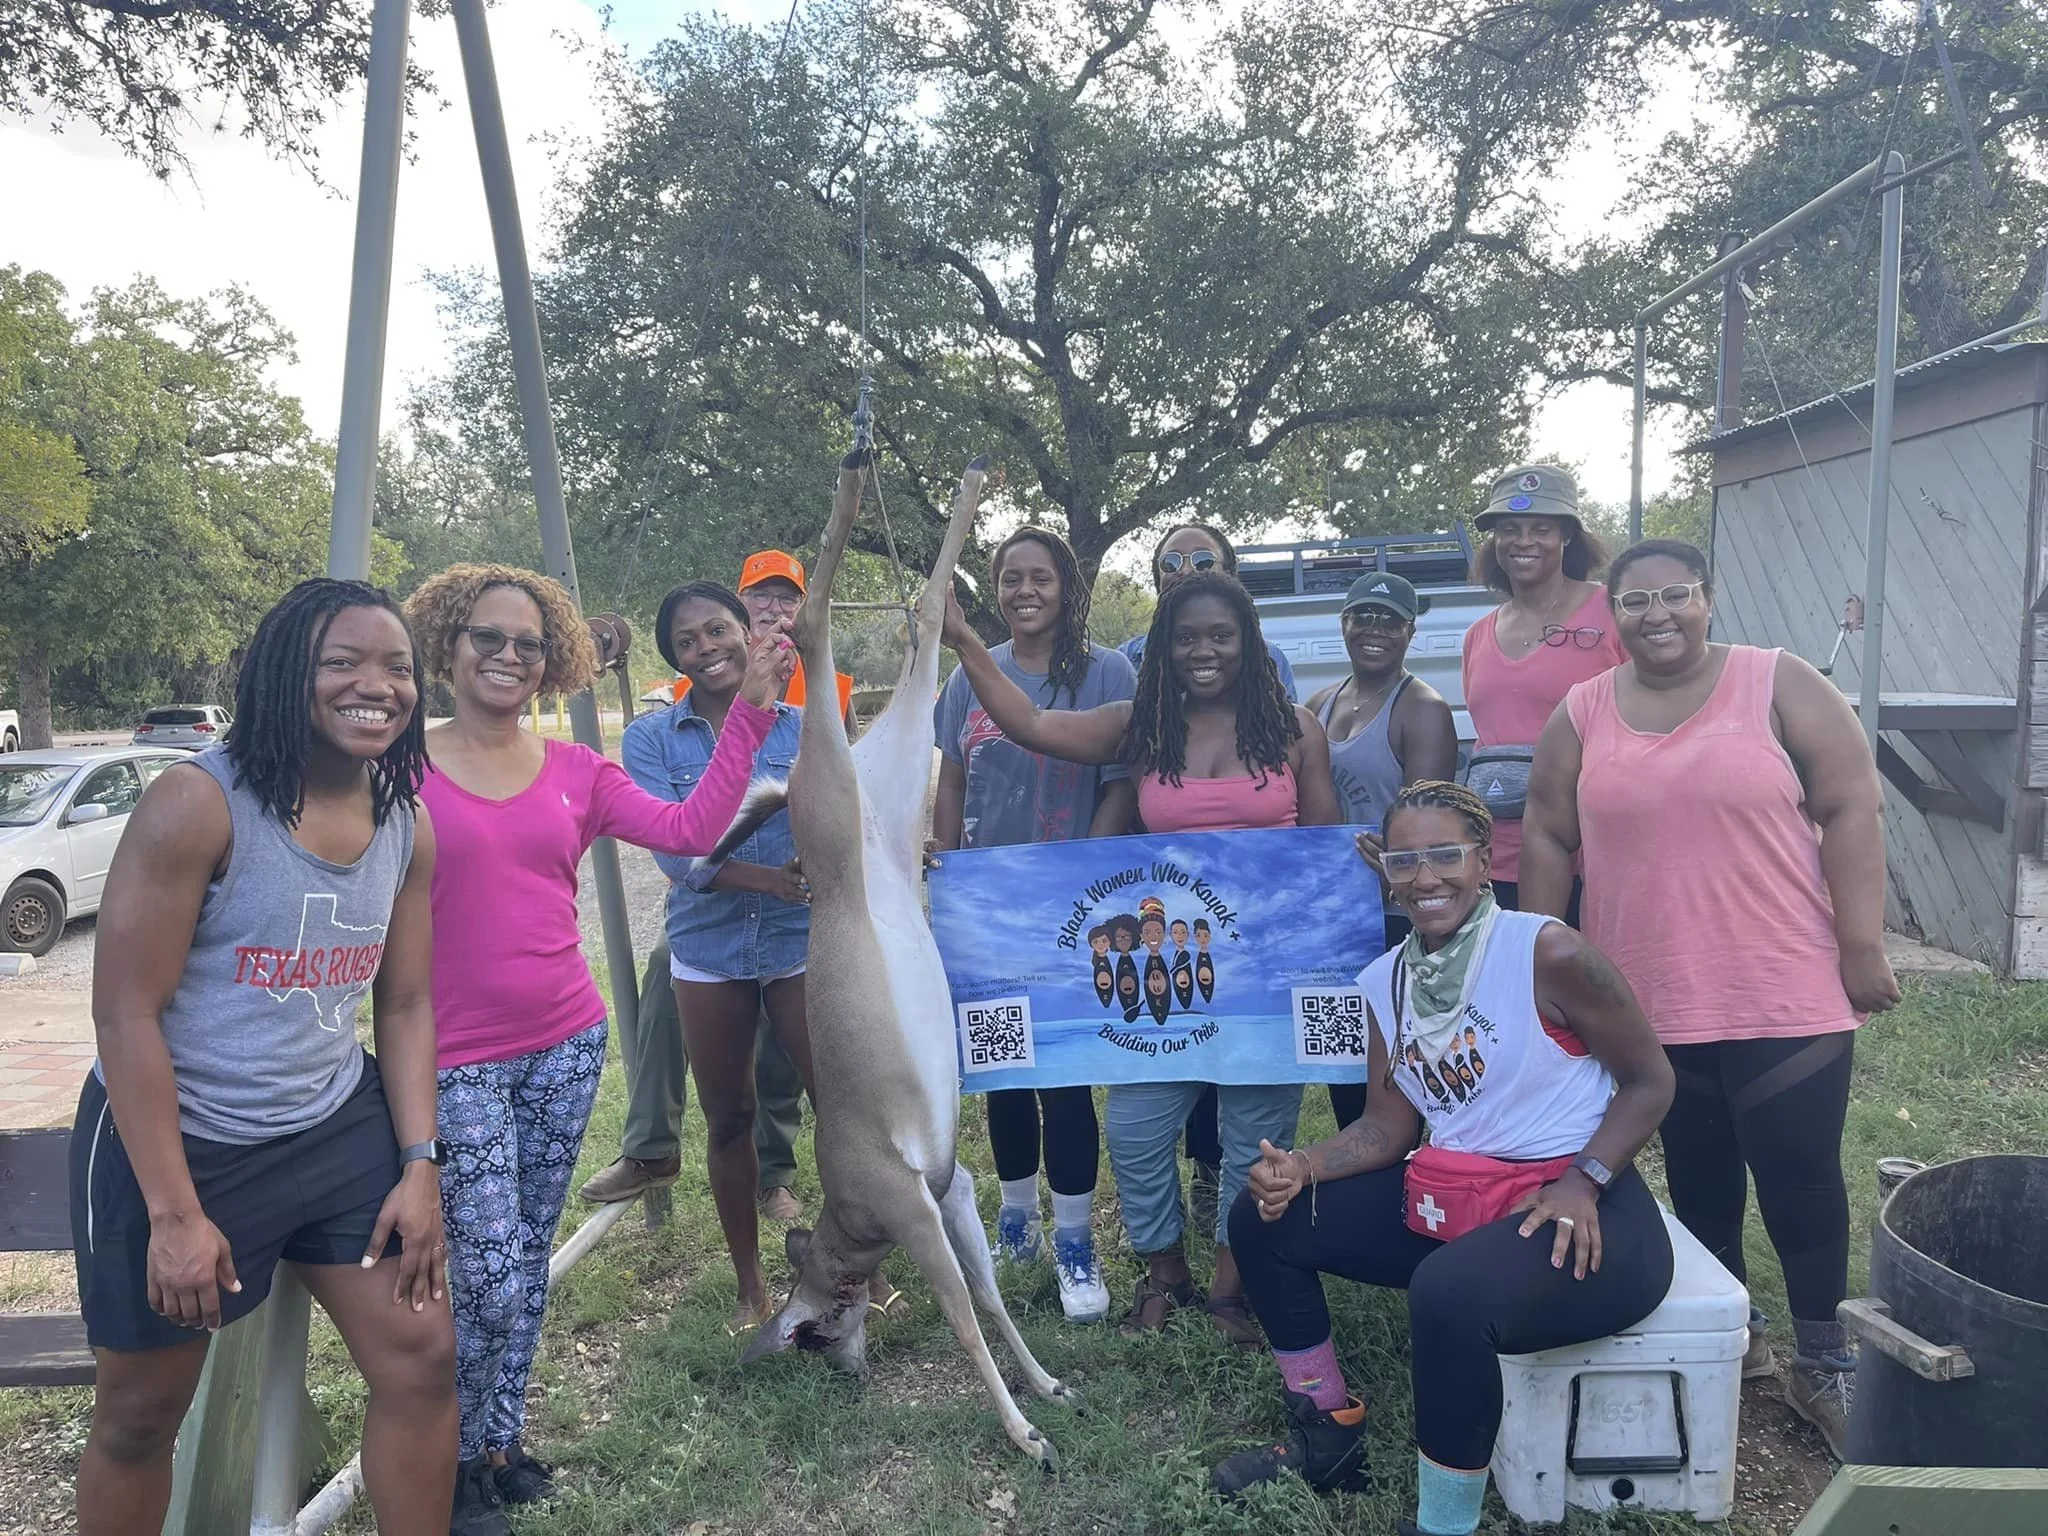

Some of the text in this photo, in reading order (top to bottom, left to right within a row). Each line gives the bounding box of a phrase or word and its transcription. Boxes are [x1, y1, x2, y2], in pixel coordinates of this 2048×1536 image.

[1057, 899, 1093, 951] Black
[1085, 867, 1146, 903] Women
[1151, 862, 1189, 887] Who
[1190, 877, 1238, 929] Kayak
[234, 945, 325, 988] TEXAS
[1097, 1021, 1220, 1057] Building Our Tribe
[1464, 1002, 1496, 1037] Kayak
